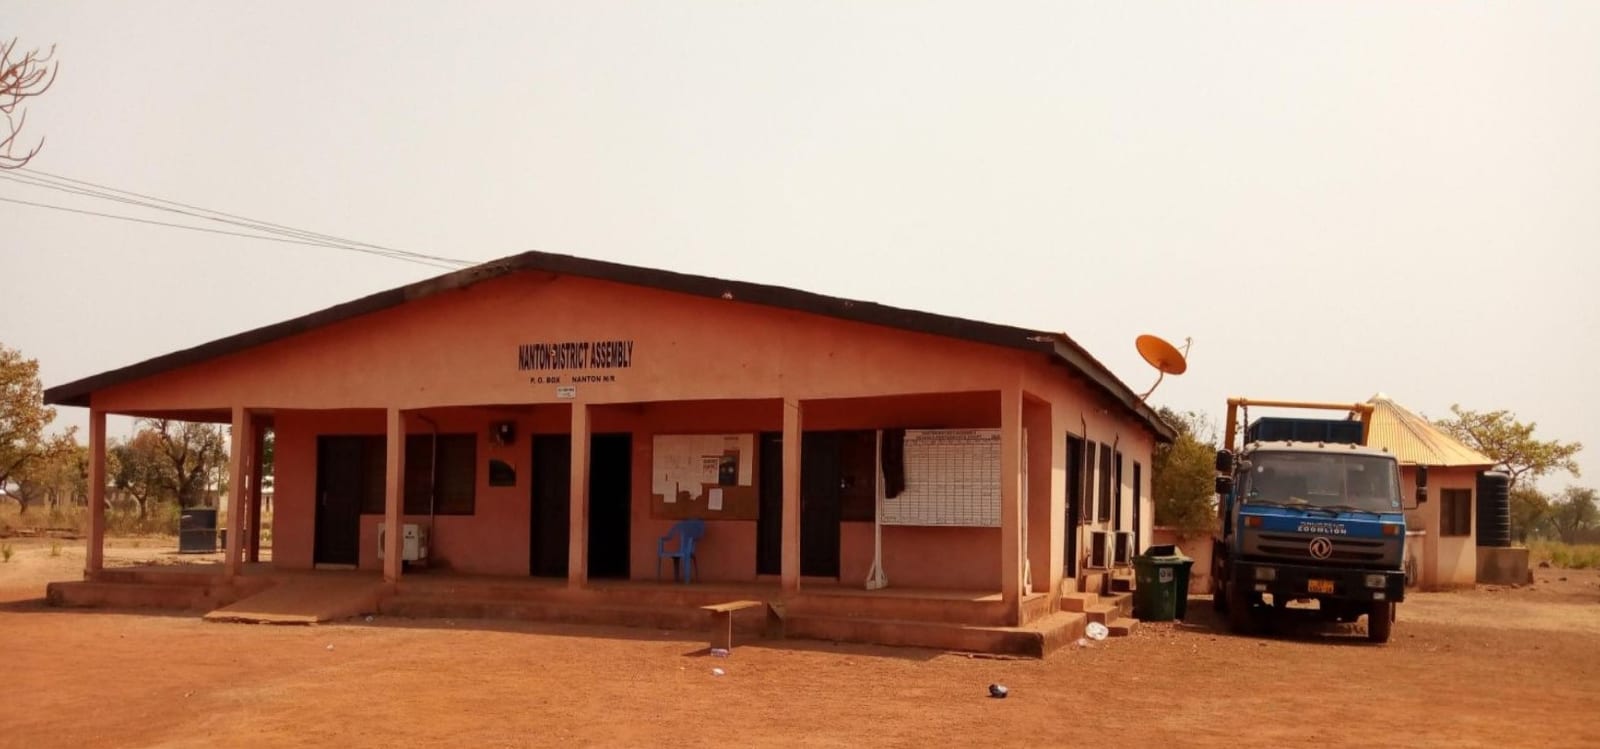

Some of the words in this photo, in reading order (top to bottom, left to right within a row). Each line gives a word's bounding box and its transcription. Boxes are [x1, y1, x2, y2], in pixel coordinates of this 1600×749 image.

[518, 343, 551, 370] NANTON
[552, 341, 588, 369] DISTRICT
[590, 340, 634, 368] ASSEMBLY
[546, 376, 560, 384] BOX
[572, 375, 601, 383] NANTON
[1297, 526, 1347, 535] ZOOMLION
